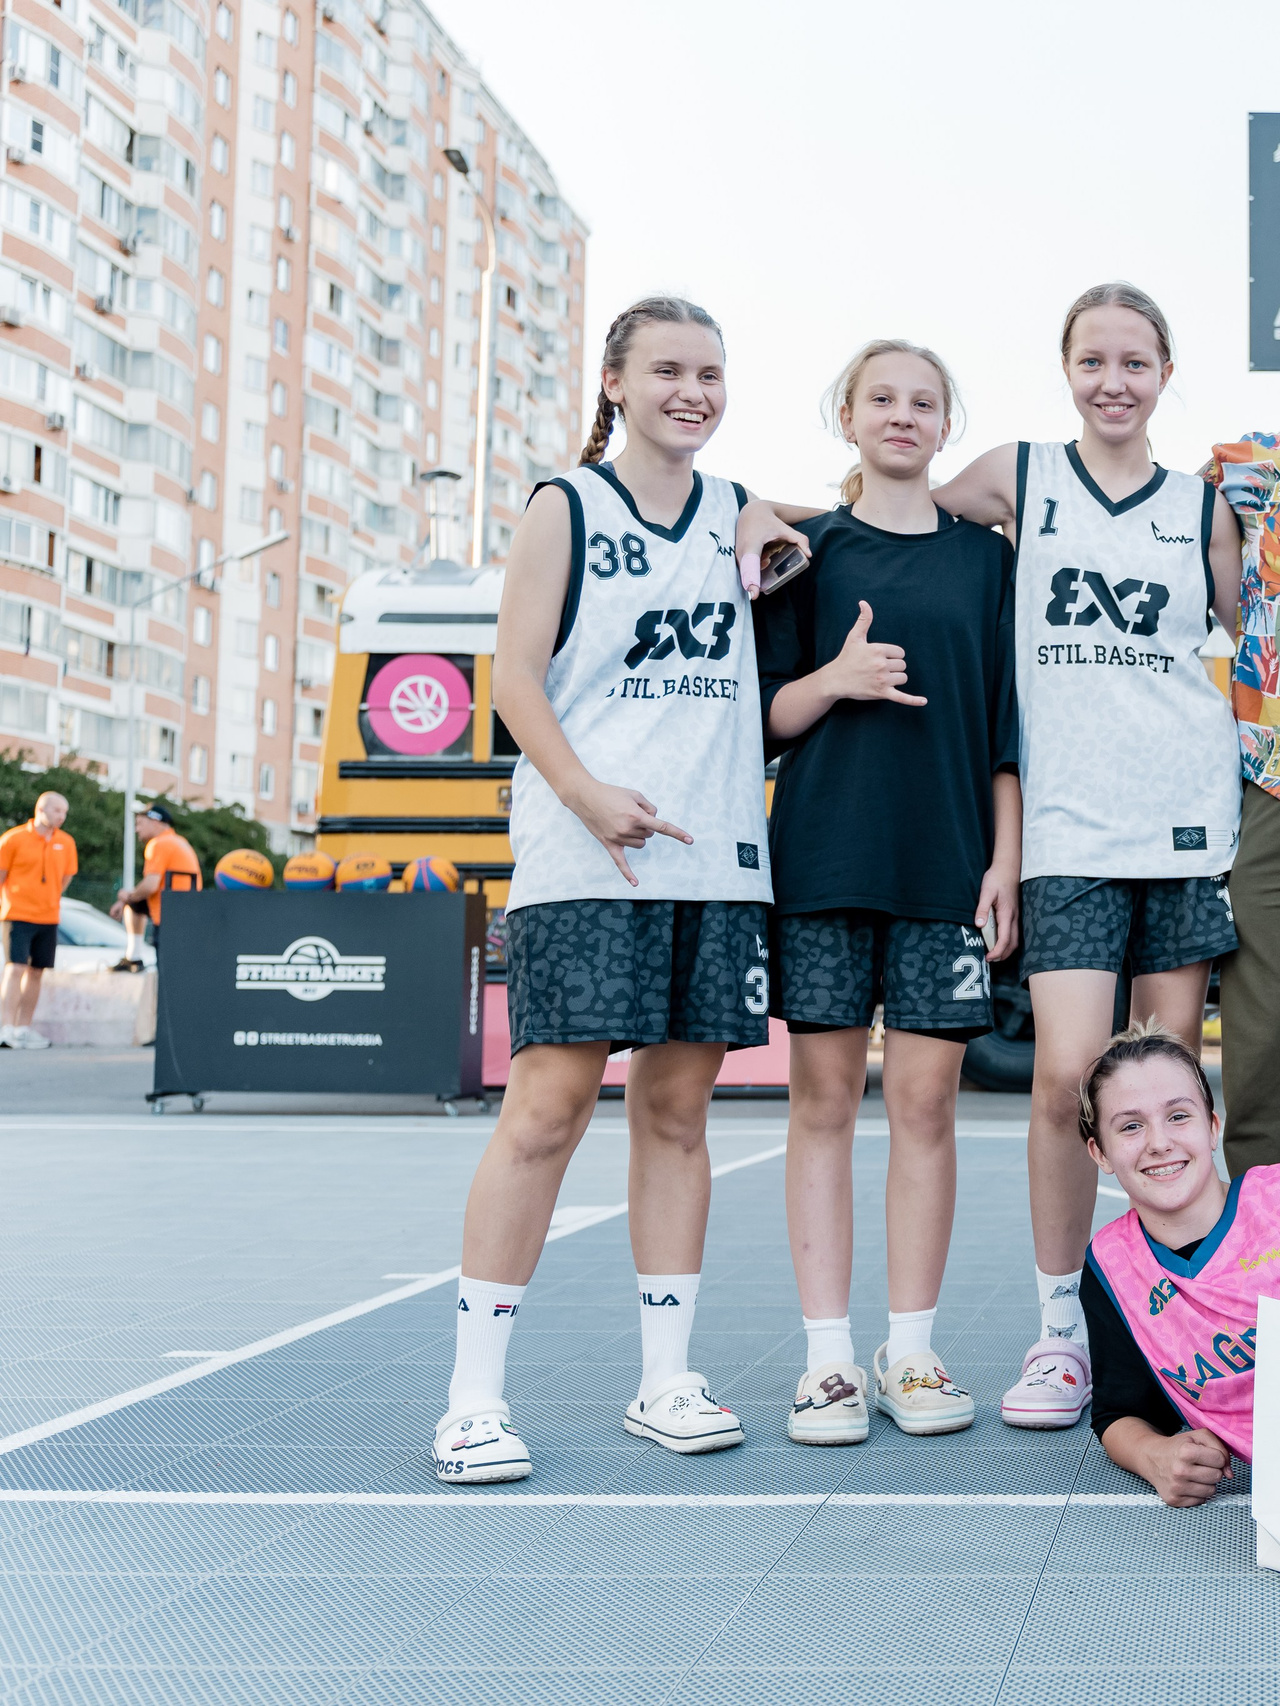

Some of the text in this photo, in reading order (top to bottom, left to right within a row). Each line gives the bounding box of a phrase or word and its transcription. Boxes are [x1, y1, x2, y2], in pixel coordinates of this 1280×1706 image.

[1038, 497, 1059, 537] 1
[588, 531, 652, 580] 38
[236, 964, 386, 982] STREETBASKET
[260, 1032, 383, 1046] STREETBASKETRUSSIA
[639, 1291, 680, 1306] ILA
